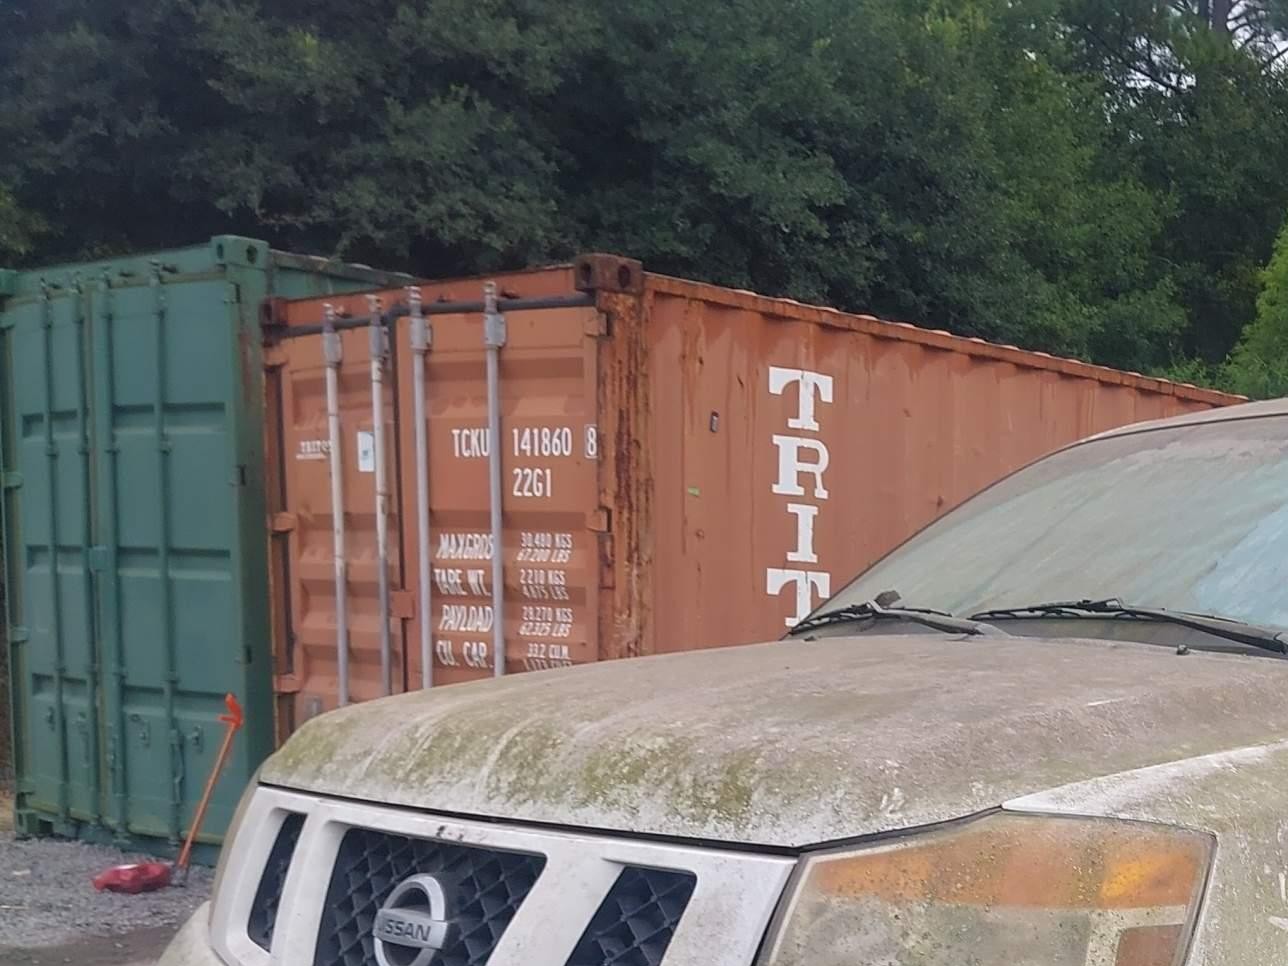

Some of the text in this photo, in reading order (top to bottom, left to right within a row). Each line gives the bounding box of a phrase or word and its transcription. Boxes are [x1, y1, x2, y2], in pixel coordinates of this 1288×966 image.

[451, 426, 598, 457] TCKU 141860 8
[512, 468, 552, 497] 22G1
[434, 568, 468, 595] TARE
[438, 604, 494, 632] PAYLOAD
